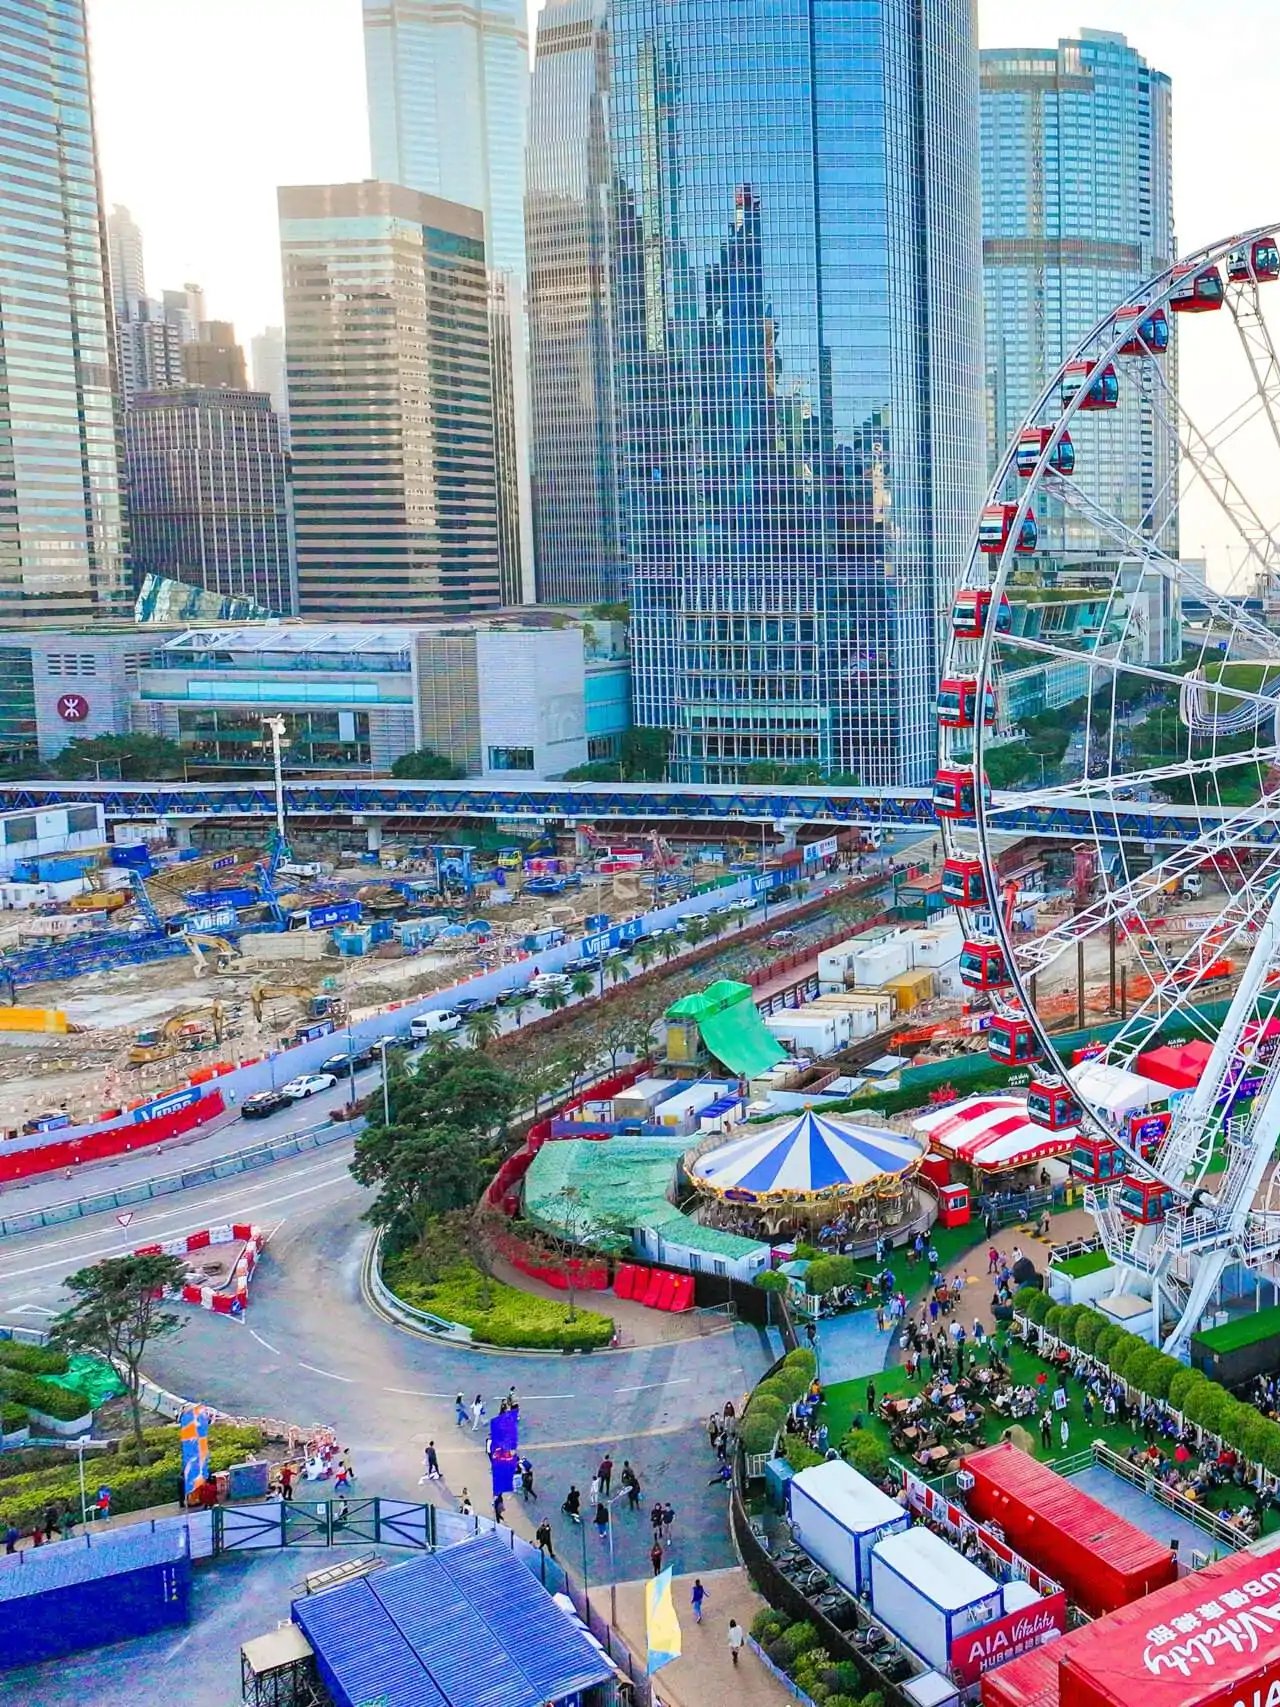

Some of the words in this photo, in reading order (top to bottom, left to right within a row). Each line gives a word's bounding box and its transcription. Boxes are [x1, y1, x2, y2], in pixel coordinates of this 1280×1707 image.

[968, 1630, 1009, 1664] AIA
[1011, 1610, 1056, 1643] Vitality
[1142, 1611, 1274, 1677] Vitality
